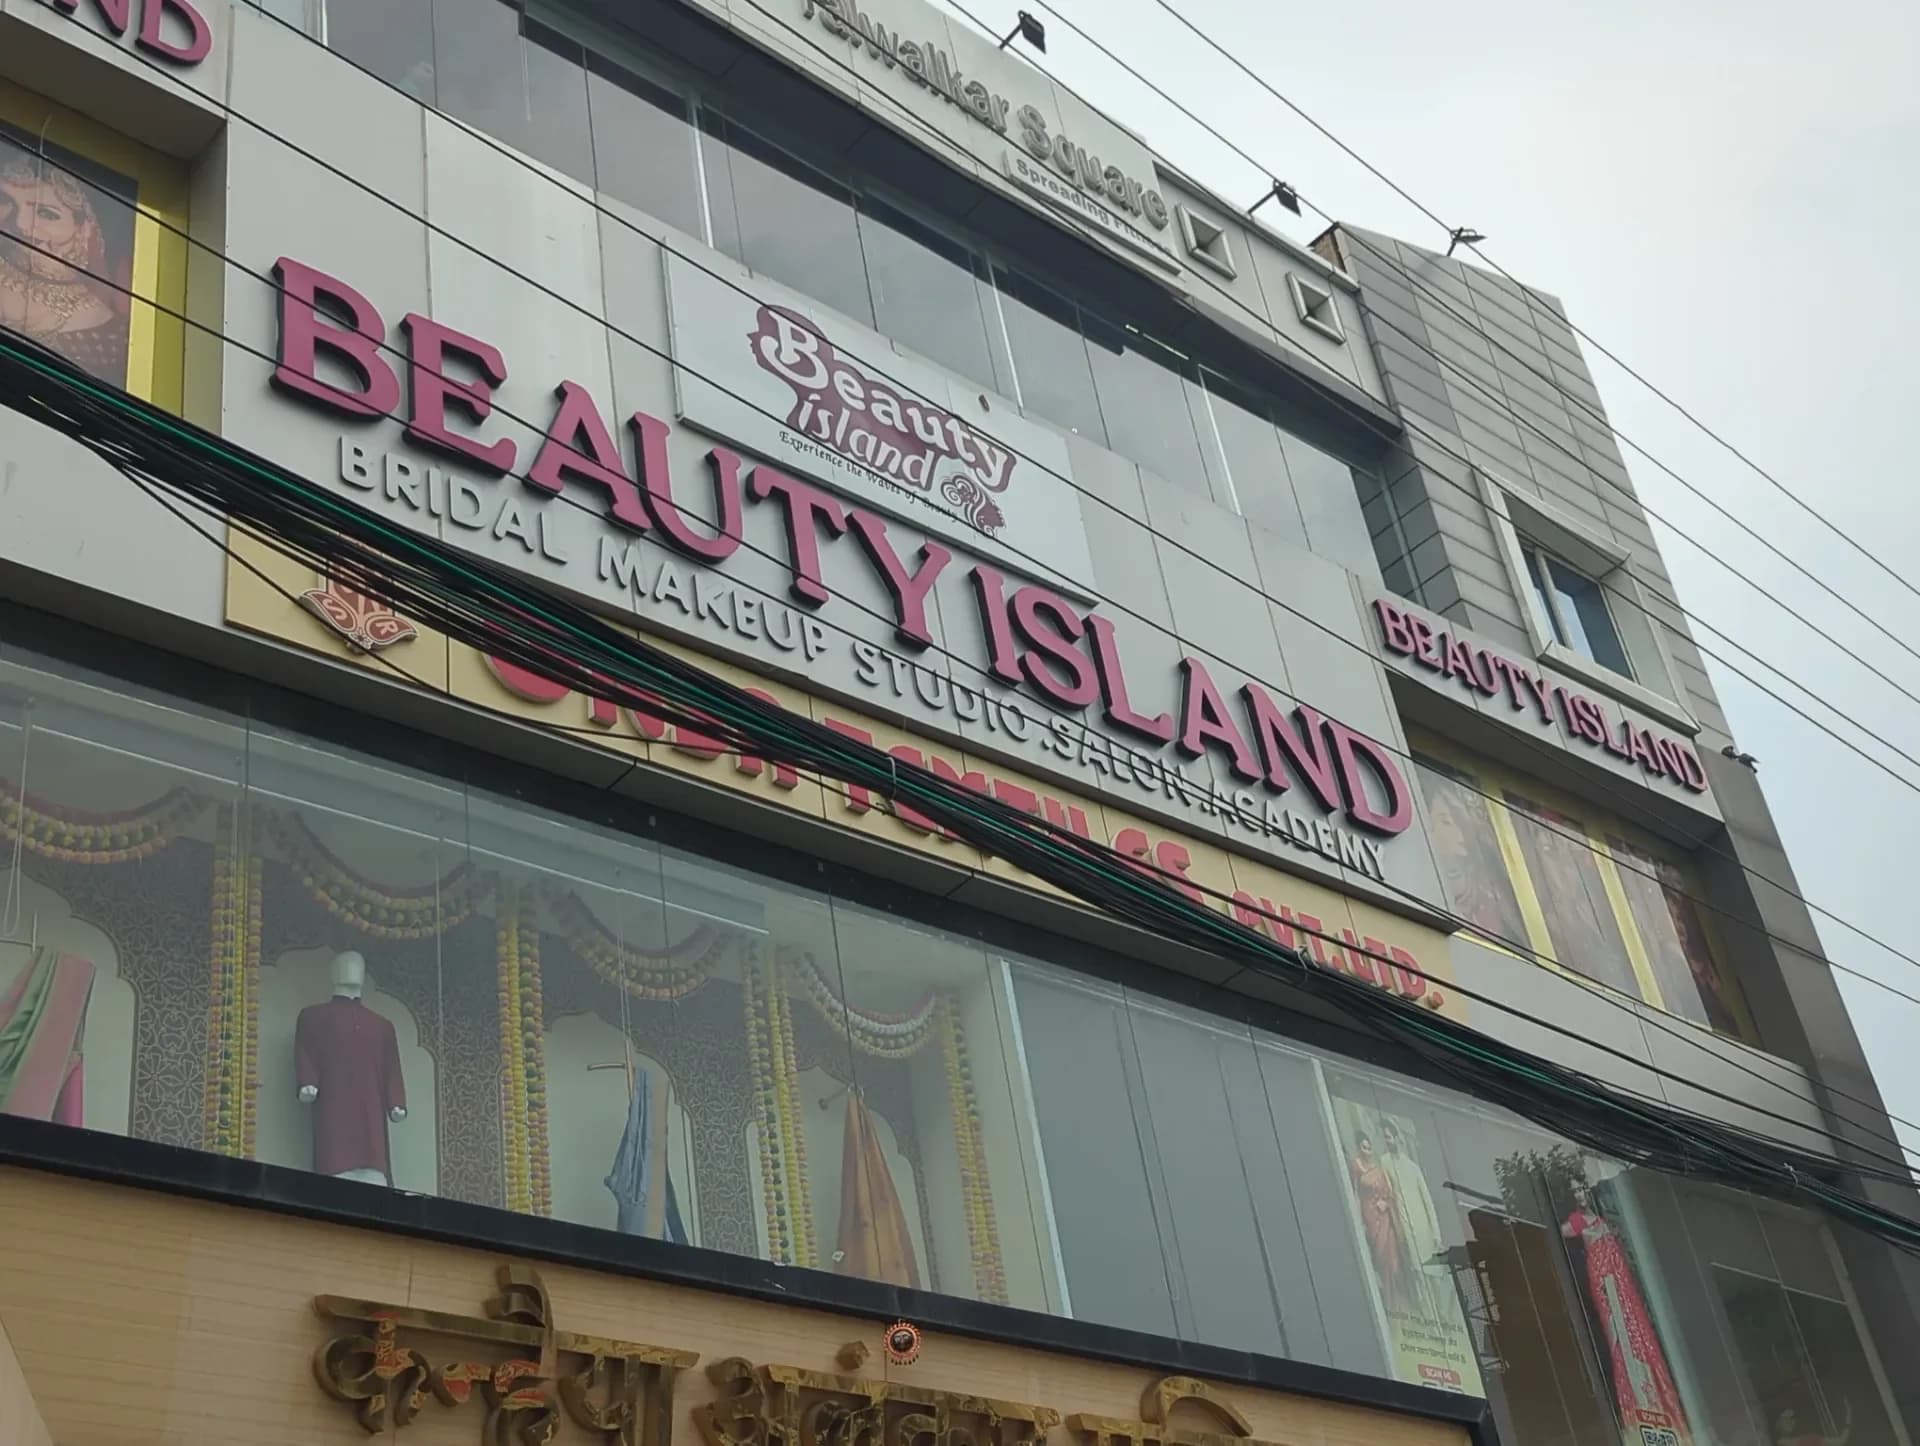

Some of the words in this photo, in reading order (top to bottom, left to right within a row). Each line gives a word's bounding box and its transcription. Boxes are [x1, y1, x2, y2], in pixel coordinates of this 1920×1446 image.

[1016, 158, 1111, 226] Spreading
[1017, 104, 1170, 231] Square
[759, 310, 1010, 488] Beauty
[779, 430, 843, 468] Experience
[846, 462, 862, 478] the
[865, 470, 901, 495] Waves
[799, 393, 937, 489] island
[271, 256, 952, 651] BEAUTY
[969, 565, 1414, 837] ISLAND
[338, 435, 568, 564] BRIDAL
[599, 536, 828, 661] MAKEUP
[851, 640, 1031, 743] STUDIO
[1375, 599, 1558, 724] BEAUTY
[1560, 690, 1709, 794] ISLAND
